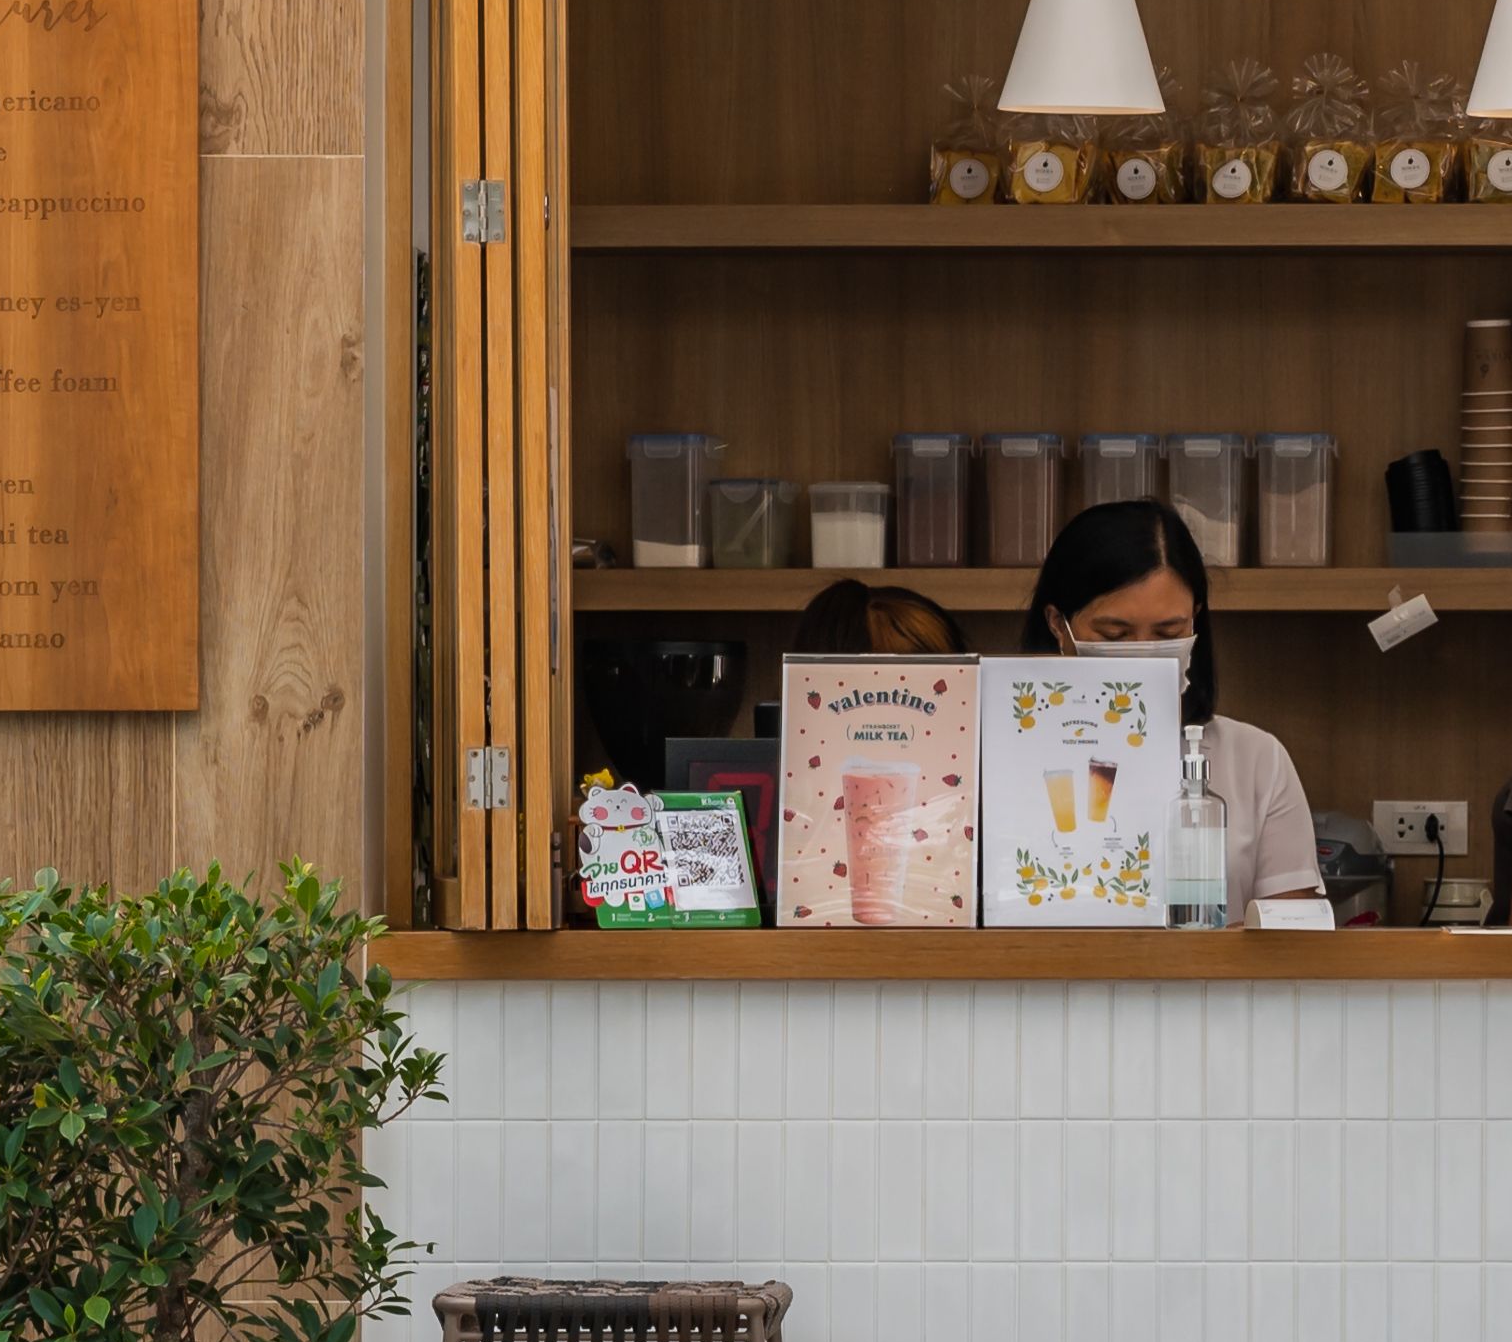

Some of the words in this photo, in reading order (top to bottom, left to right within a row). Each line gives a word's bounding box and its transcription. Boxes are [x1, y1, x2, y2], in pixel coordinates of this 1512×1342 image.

[54, 296, 143, 319] es-yen
[50, 369, 118, 393] foam
[27, 525, 70, 546] tea
[50, 577, 100, 604] yen
[827, 688, 938, 716] valentine
[853, 731, 885, 740] MILK
[887, 731, 909, 740] TEA
[582, 854, 619, 879] จ่าย
[619, 849, 665, 875] QR
